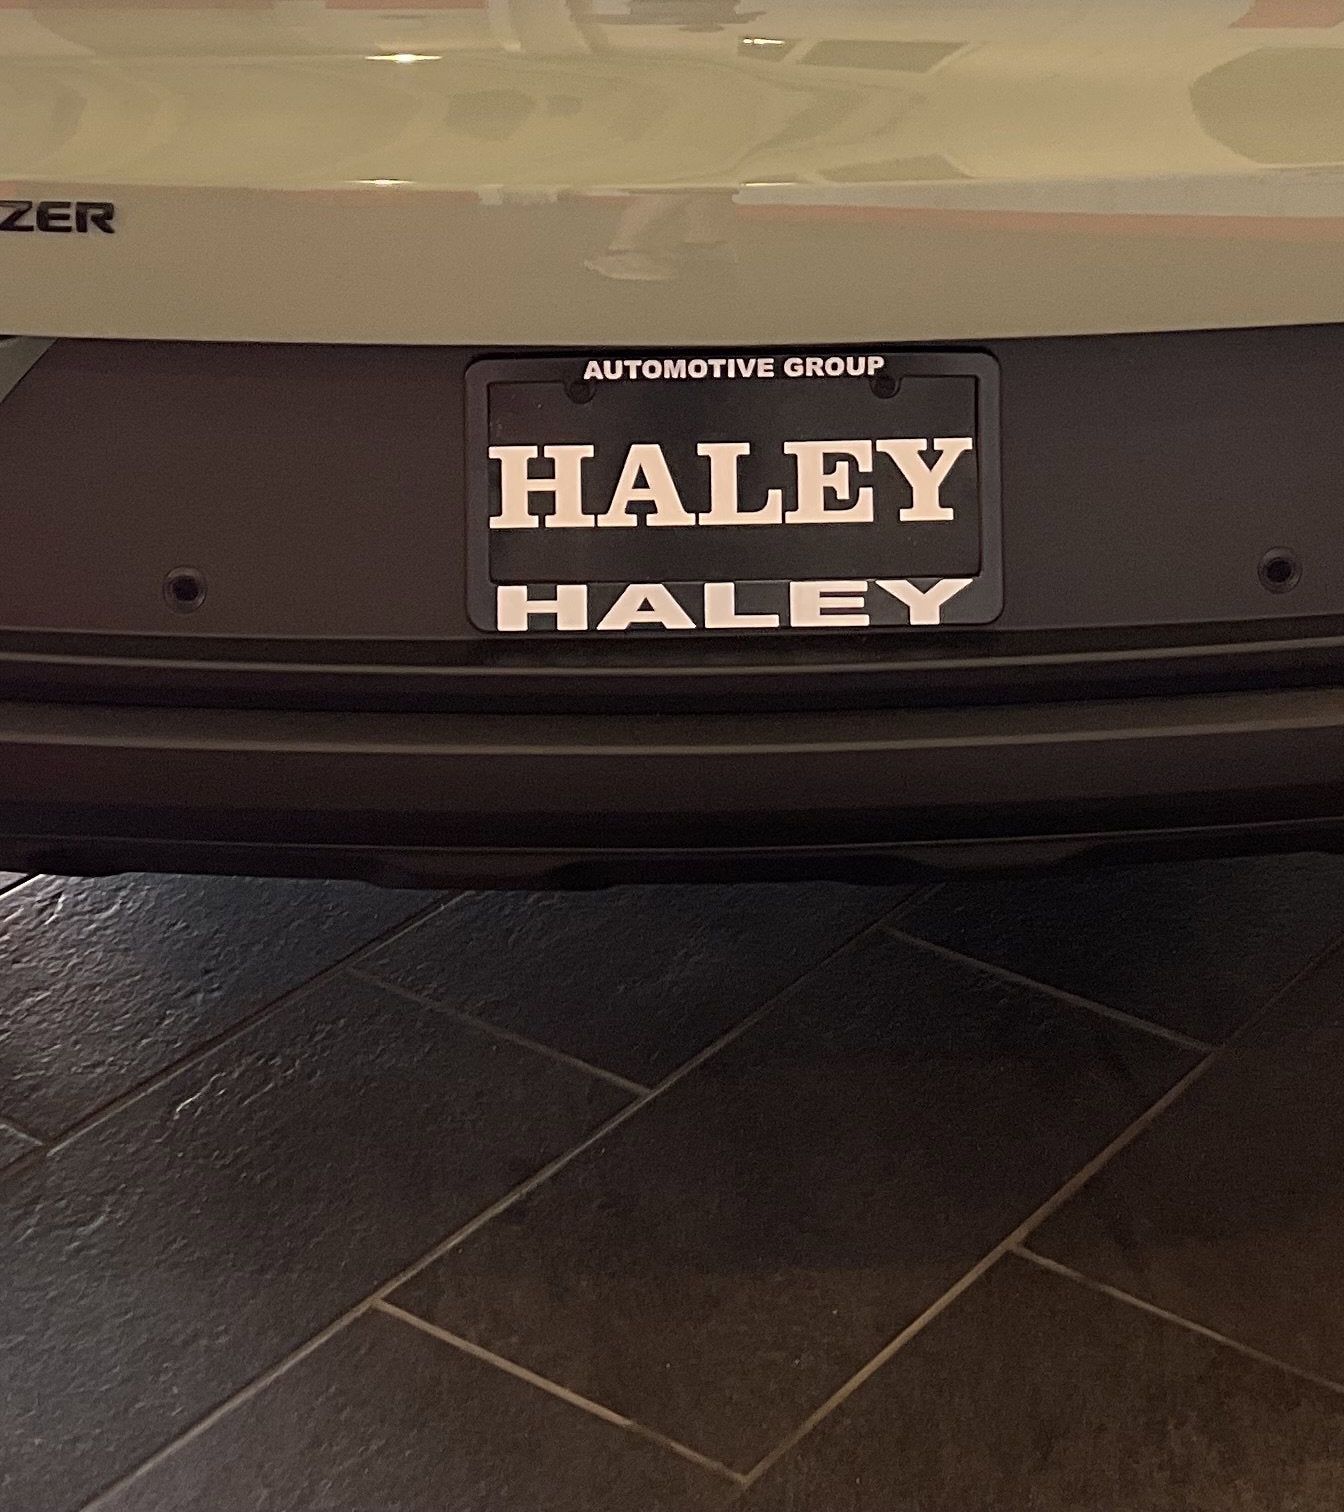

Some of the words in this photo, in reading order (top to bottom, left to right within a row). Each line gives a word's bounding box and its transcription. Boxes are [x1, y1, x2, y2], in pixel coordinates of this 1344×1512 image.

[583, 358, 774, 380] AUTOMOTIVE
[784, 356, 886, 377] GROUP
[488, 437, 973, 529] HALEY
[496, 578, 974, 631] HALEY
